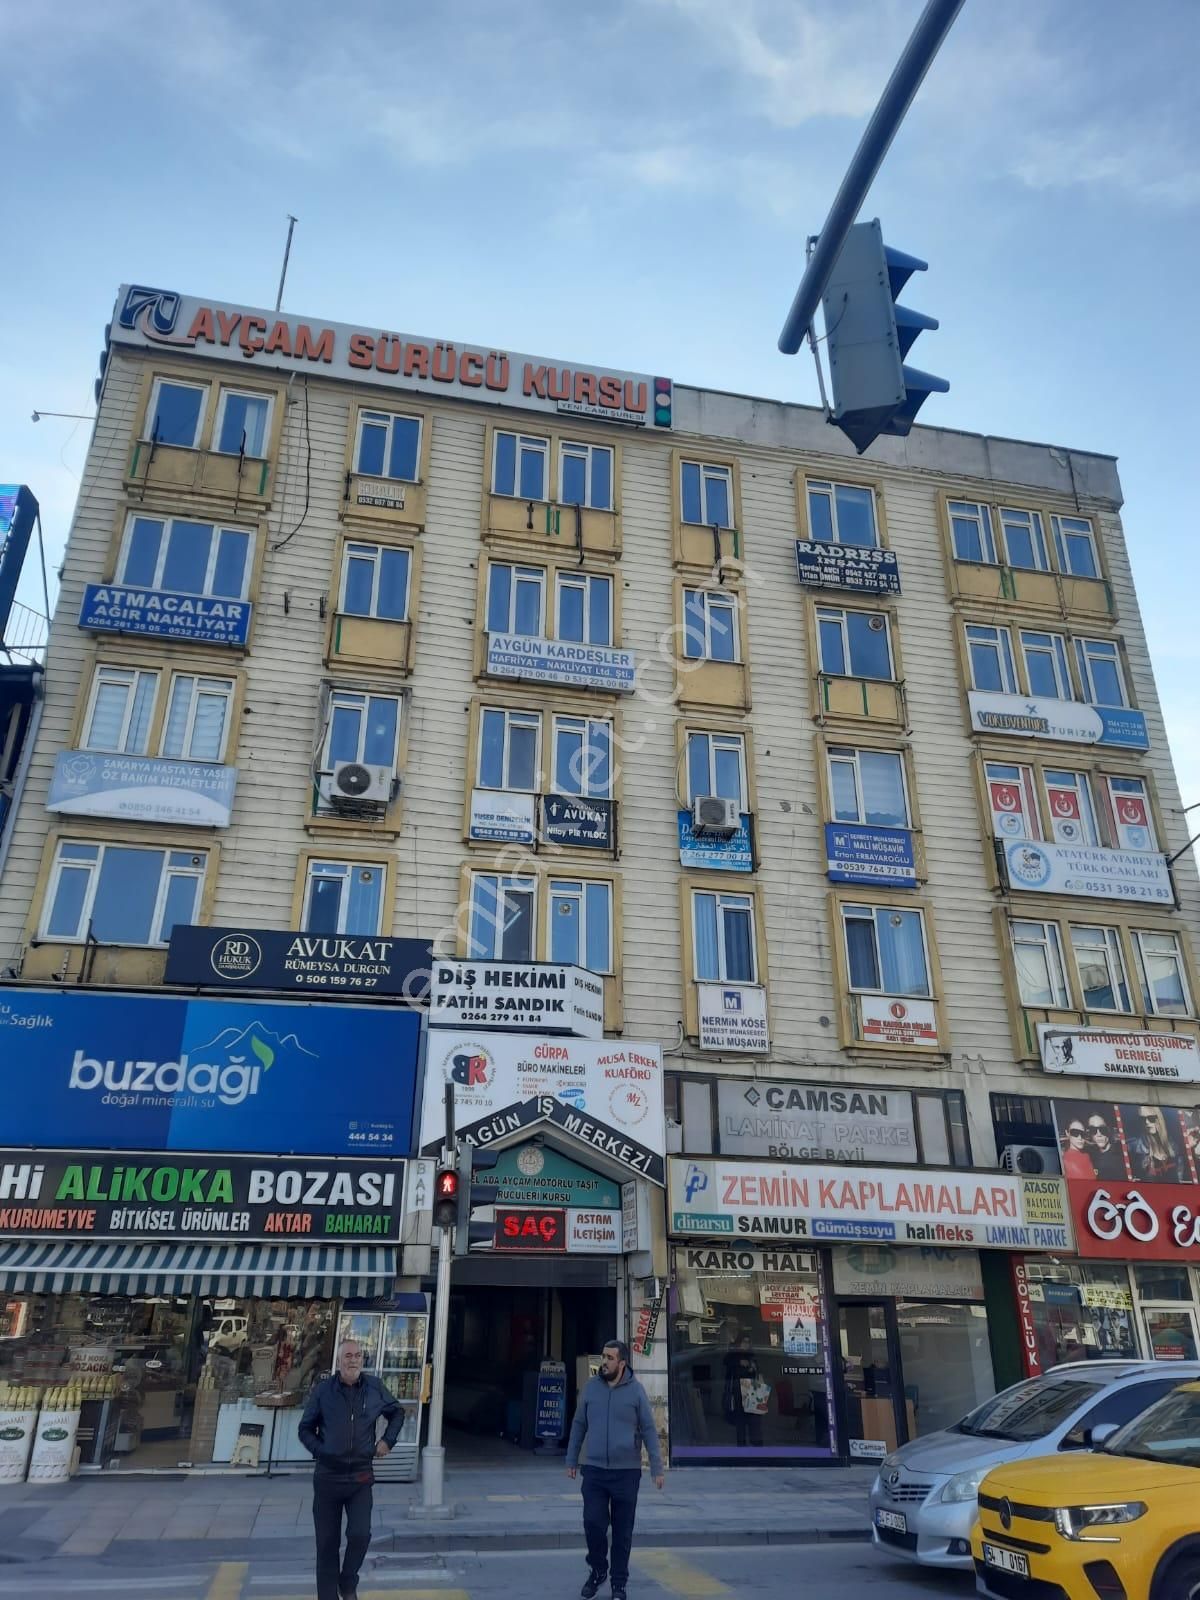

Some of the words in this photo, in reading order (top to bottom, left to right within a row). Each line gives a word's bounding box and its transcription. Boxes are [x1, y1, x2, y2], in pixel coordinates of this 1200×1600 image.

[187, 307, 335, 358] AYÇAM
[349, 331, 509, 392] SÜRÜCÜ
[522, 362, 648, 414] KURSU
[798, 541, 896, 564] RADRESS
[93, 589, 241, 619] ATMACALAR
[87, 616, 111, 627] 0264
[168, 627, 192, 636] 0532
[94, 604, 140, 621] AĞIR
[147, 612, 238, 632] NAKLİYAT
[493, 637, 542, 655] AYGÜN
[490, 653, 538, 667] HAFRİYAT
[546, 661, 592, 674] NAKLİYAT
[103, 759, 150, 772] SAKARYA
[153, 765, 186, 776] HASTA
[188, 767, 200, 777] VE
[563, 808, 608, 823] AVUKAT
[1066, 860, 1098, 873] TÜRK
[1086, 882, 1112, 893] 0531
[286, 937, 393, 962] AVUKAT
[219, 955, 252, 965] HUKUK
[284, 958, 340, 972] RÜMEYSA
[343, 963, 391, 976] DURGUN
[295, 974, 303, 983] 0
[306, 974, 327, 985] 506
[329, 976, 347, 986] 159
[350, 977, 362, 987] 76
[364, 978, 378, 988] 27
[438, 964, 477, 990] DİŞ
[484, 967, 566, 990] HEKİMİ
[436, 991, 488, 1009] FATİH
[494, 996, 565, 1013] SANDIK
[10, 1013, 54, 1029] Sağlık
[461, 1012, 487, 1021] 0264
[490, 1013, 509, 1022] 279
[512, 1014, 525, 1022] 41
[528, 1014, 542, 1023] 84
[741, 1016, 766, 1029] KÖSE
[534, 1043, 569, 1060] GÜRPA
[597, 1052, 626, 1066] MUSA
[628, 1052, 659, 1069] ERKEK
[1115, 1048, 1162, 1063] DERNEĞİ
[69, 1049, 260, 1105] buzdağı
[517, 1060, 538, 1074] BÜRO
[539, 1062, 586, 1076] MAKİNELERİ
[604, 1066, 651, 1081] KUAFÖRÜ
[1104, 1063, 1146, 1075] SAKARYA
[1148, 1065, 1179, 1078] ŞUBESİ
[101, 1093, 139, 1108] doğal
[200, 1098, 216, 1108] su
[348, 1132, 366, 1142] 444
[368, 1133, 380, 1142] 54
[382, 1133, 393, 1142] 34
[725, 1115, 826, 1141] LAMİNAT
[834, 1122, 910, 1147] PARKE
[564, 1113, 653, 1173] MERKEZİ
[768, 1142, 821, 1159] BÖLGE
[55, 1165, 234, 1203] ALİKOKA
[247, 1169, 396, 1207] BOZASI
[483, 1176, 499, 1184] ADA
[502, 1176, 531, 1188] AYÇAM
[533, 1178, 573, 1189] MOTORLU
[575, 1180, 599, 1192] TAŞIT
[1024, 1181, 1060, 1195] ATASOY
[542, 1191, 571, 1202] KURSU
[721, 1170, 810, 1208] ZEMİN
[818, 1178, 1018, 1218] KAPLAMALARI
[109, 1207, 176, 1231] BİTKİSEL
[181, 1207, 250, 1232] ÜRÜNLER
[264, 1212, 312, 1233] AKTAR
[325, 1214, 392, 1234] BAHARAT
[503, 1215, 557, 1242] SAÇ
[677, 1214, 730, 1231] dinarsu
[738, 1215, 808, 1235] SAMUR
[815, 1220, 893, 1238] Gümüşsuyu
[573, 1227, 616, 1242] İLETİŞİM
[906, 1222, 974, 1242] halıfleks
[985, 1225, 1030, 1246] LAMİNAT
[1034, 1229, 1068, 1247] PARKE
[687, 1249, 755, 1270] KARO
[762, 1252, 817, 1273] HALI
[1015, 1264, 1039, 1367] GÖZLÜK
[1000, 1550, 1005, 1567] T
